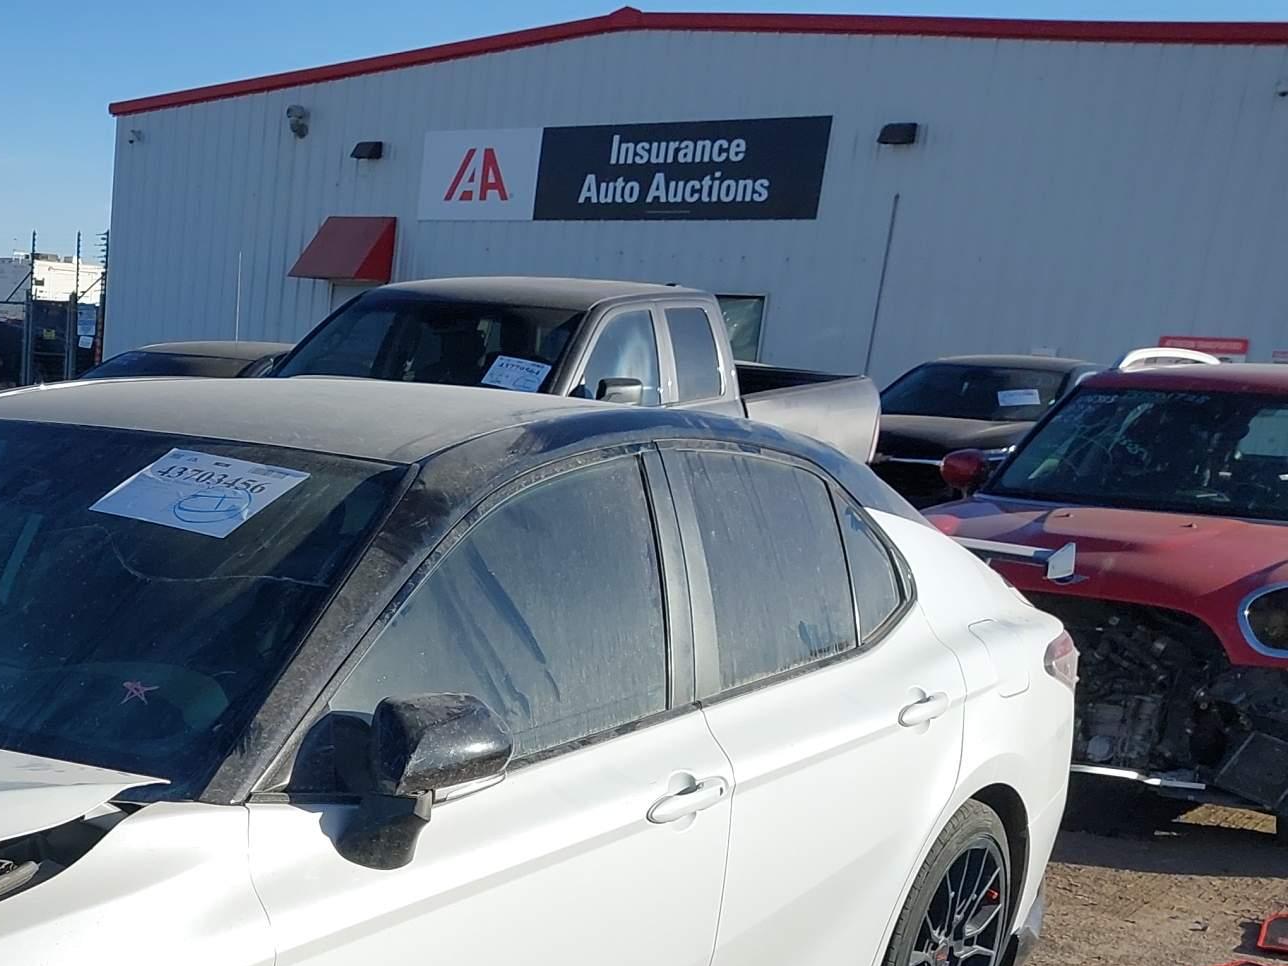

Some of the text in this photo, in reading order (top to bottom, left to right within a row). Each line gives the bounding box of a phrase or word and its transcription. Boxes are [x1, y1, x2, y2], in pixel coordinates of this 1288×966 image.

[609, 134, 746, 166] Insurance
[578, 171, 770, 204] Auto Auctions
[158, 465, 268, 494] 43703456
